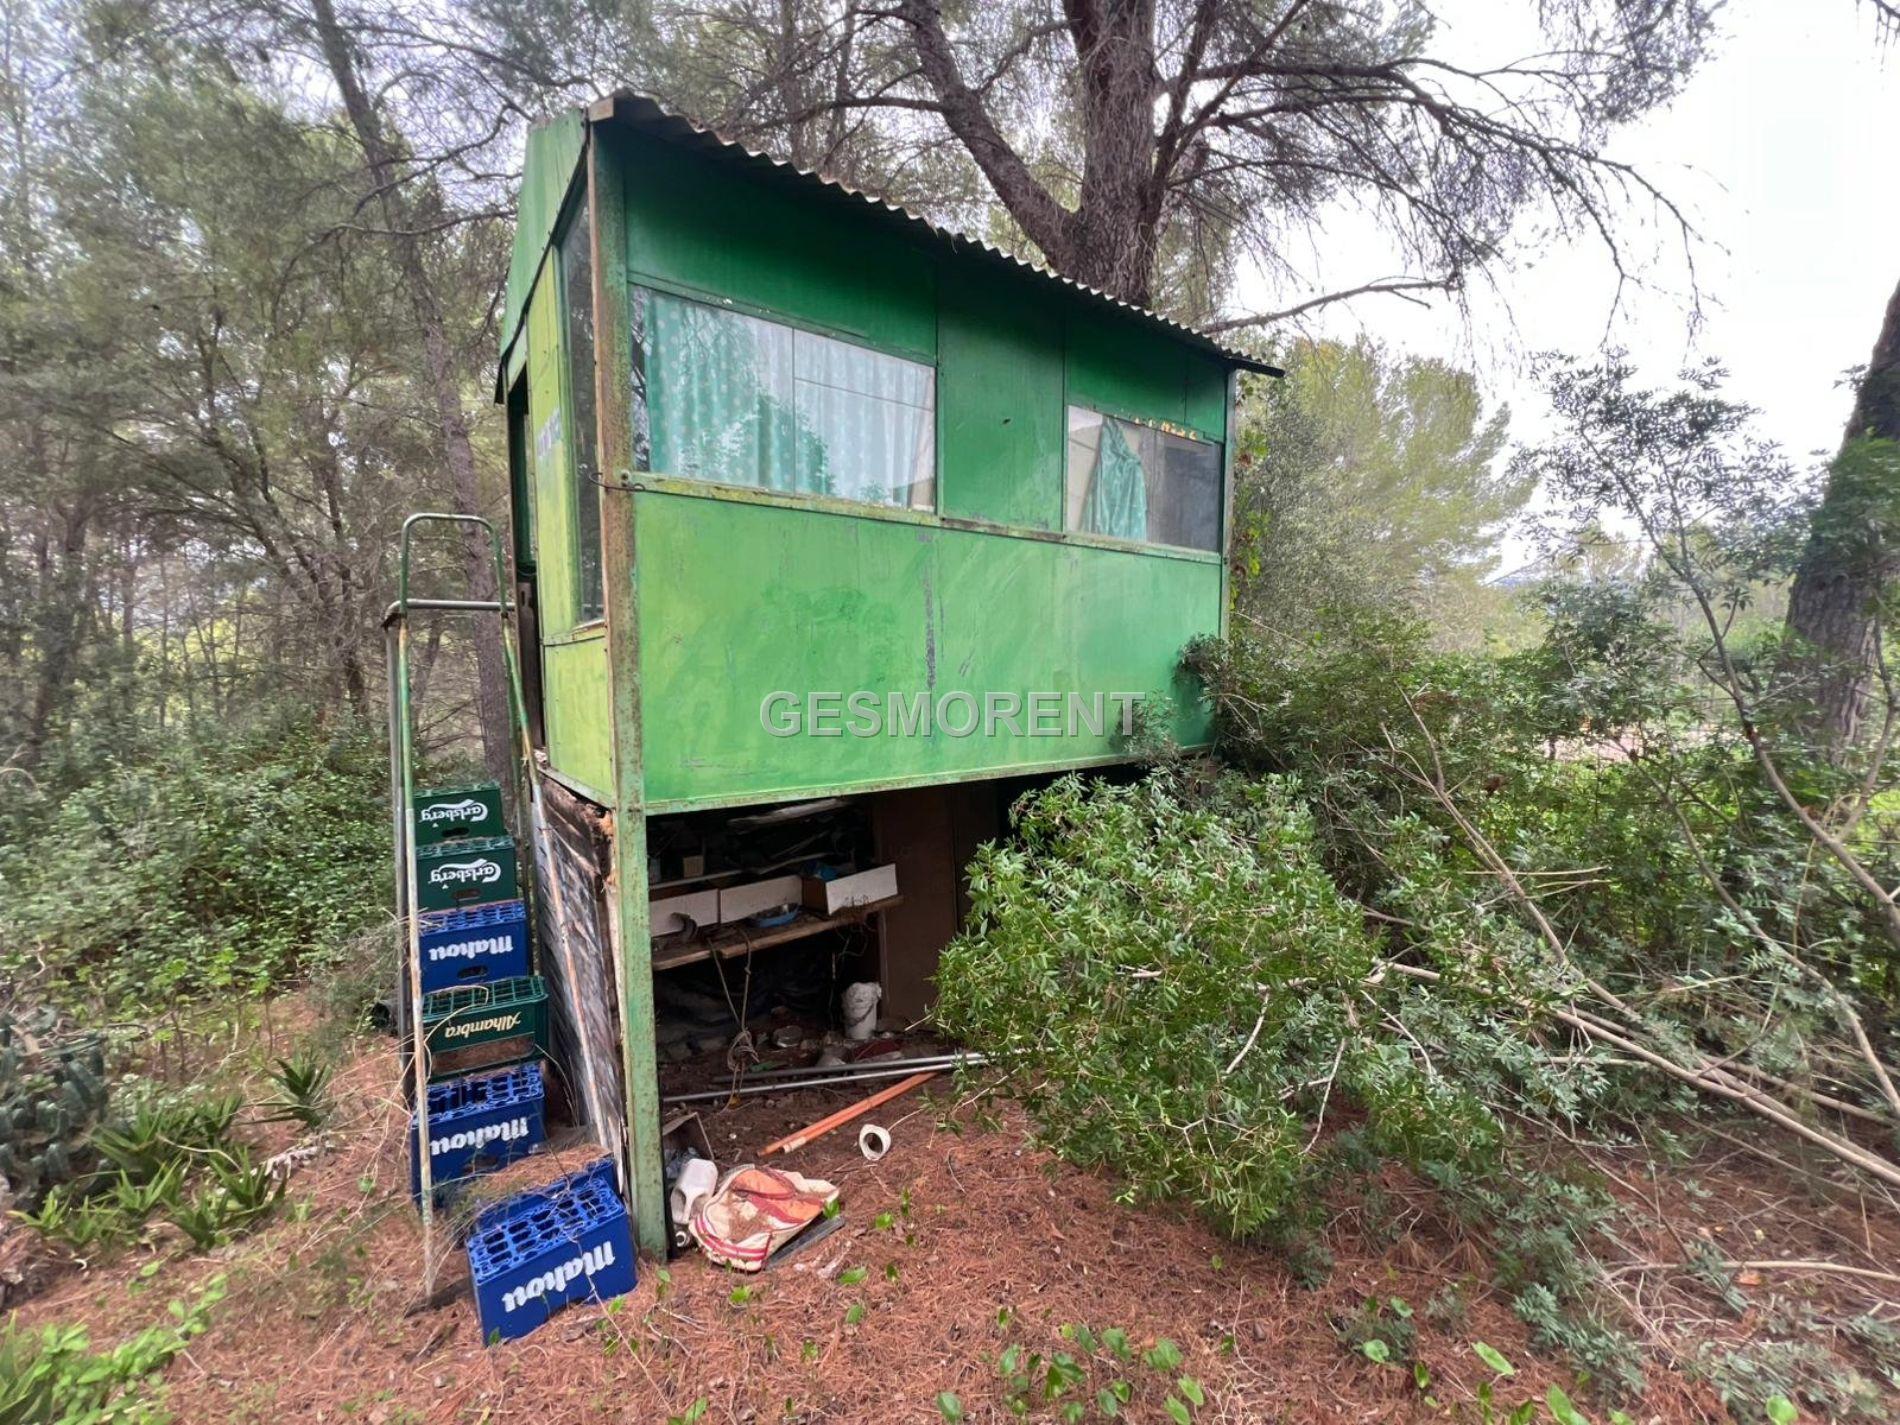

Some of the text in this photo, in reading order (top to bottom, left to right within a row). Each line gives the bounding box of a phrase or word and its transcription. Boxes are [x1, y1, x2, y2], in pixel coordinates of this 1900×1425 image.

[420, 799, 489, 823] Carlsberg
[430, 858, 502, 883] Carlsberg
[429, 935, 514, 961] Mahou
[445, 1011, 521, 1039] Alhambra
[429, 1116, 530, 1156] Mahou
[501, 1241, 616, 1313] Mahou
